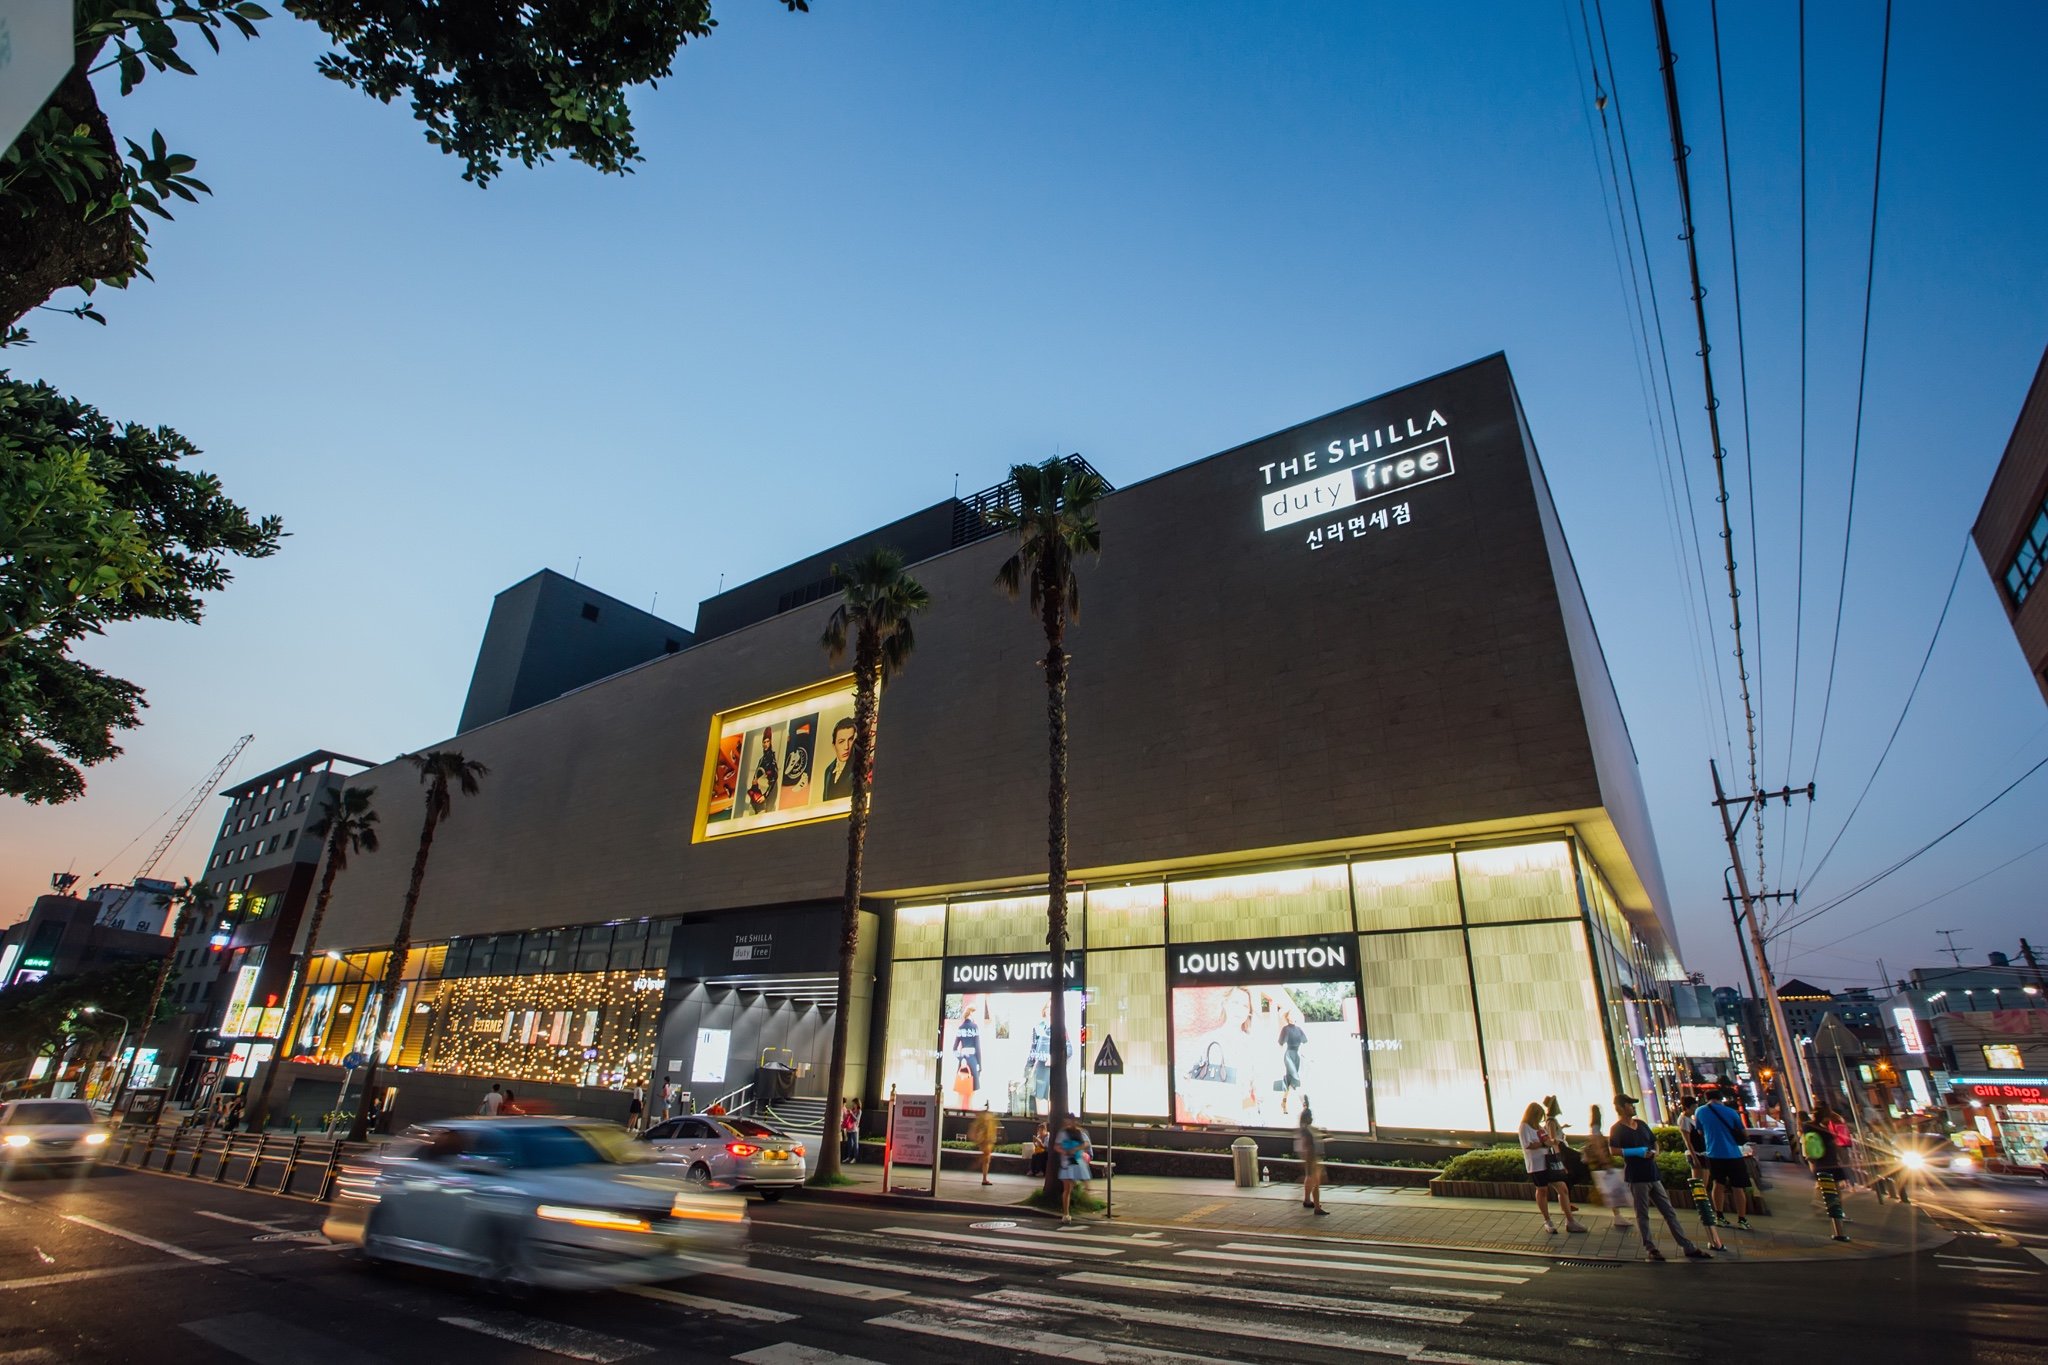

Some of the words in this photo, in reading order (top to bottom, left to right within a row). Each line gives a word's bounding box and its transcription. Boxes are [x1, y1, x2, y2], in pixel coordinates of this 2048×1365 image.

[1259, 451, 1317, 485] THE
[1327, 409, 1448, 464] SHILLA
[1273, 481, 1342, 516] duty
[1364, 451, 1440, 490] free
[1306, 502, 1411, 551] 신라면세점
[748, 934, 772, 943] SHILLA
[735, 948, 751, 958] duty
[753, 947, 768, 956] free
[1179, 951, 1239, 973] LOUIS
[1245, 946, 1346, 970] VUITTON
[953, 965, 998, 982] LOUIS
[1974, 1085, 2000, 1096] Gift
[2003, 1085, 2041, 1098] Shop
